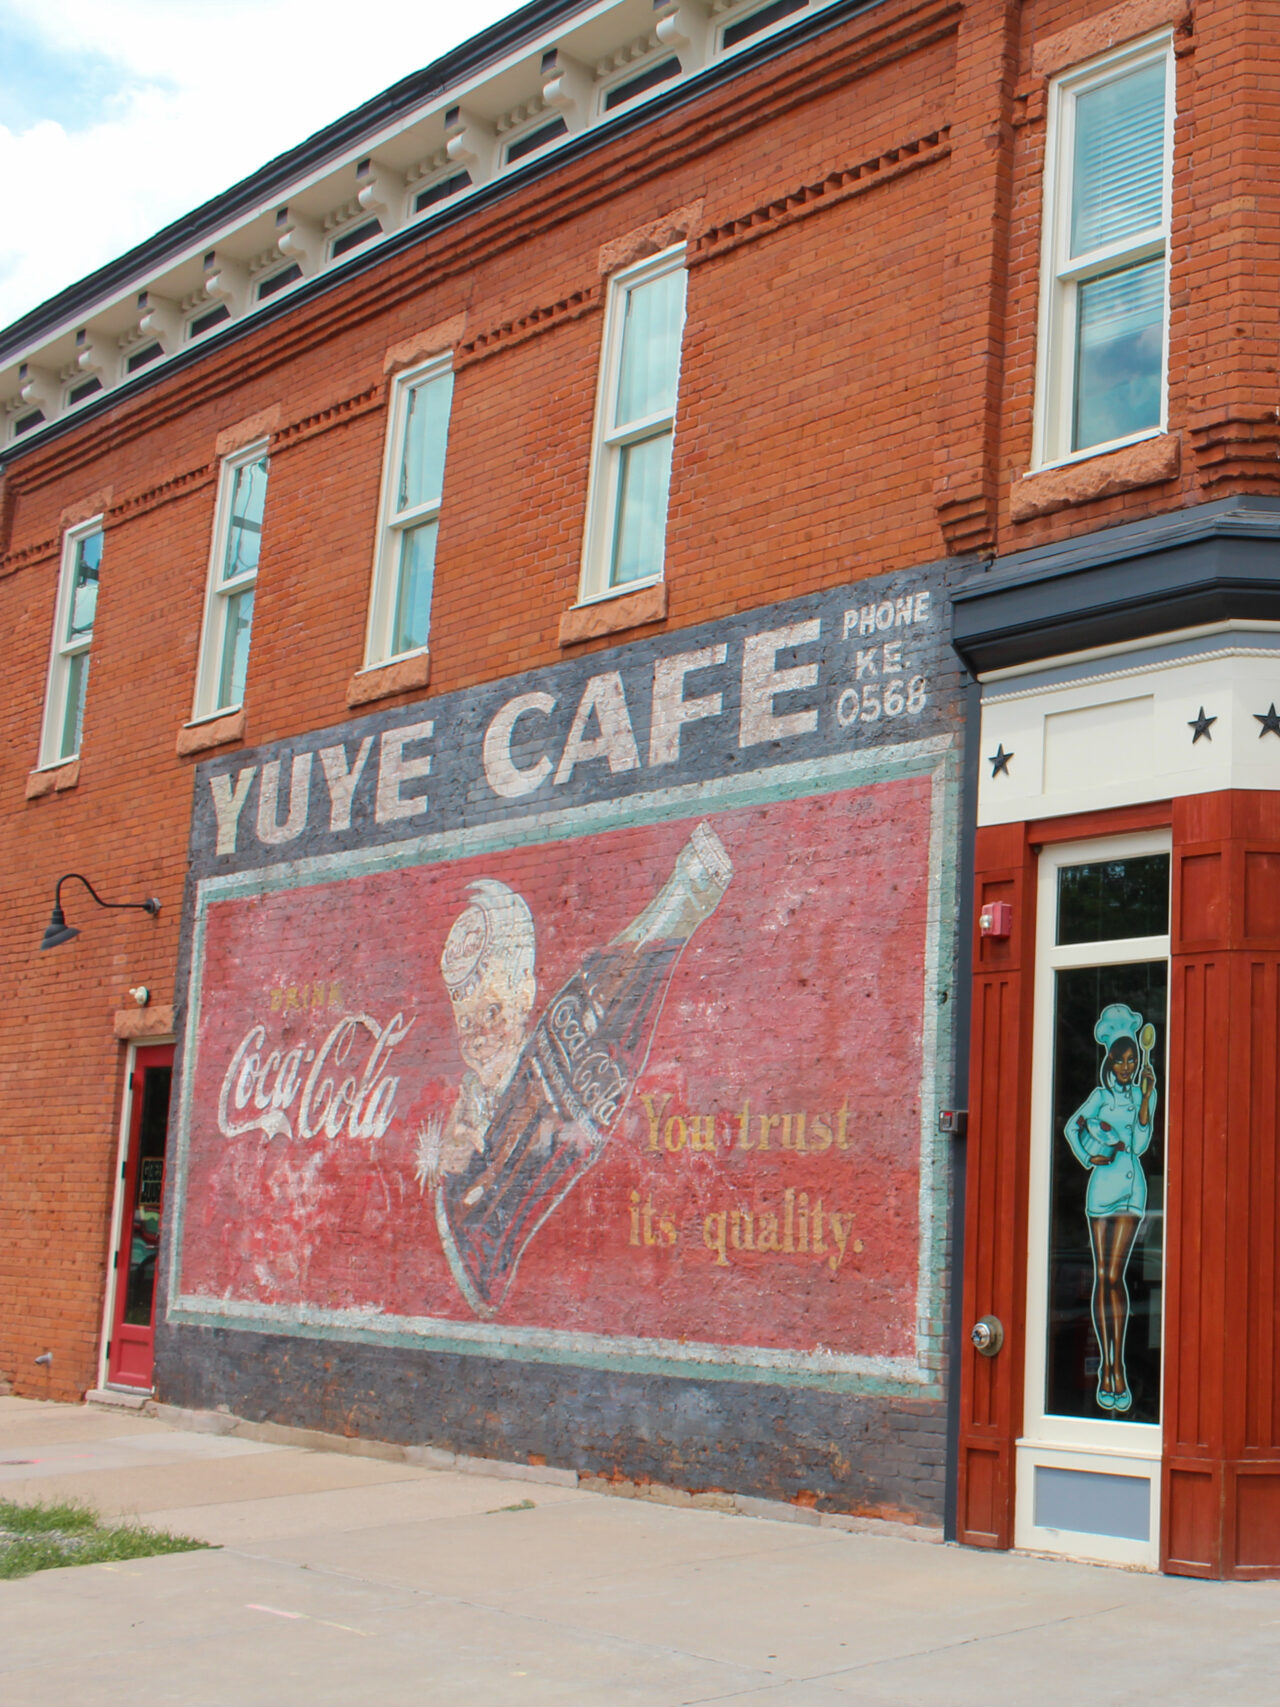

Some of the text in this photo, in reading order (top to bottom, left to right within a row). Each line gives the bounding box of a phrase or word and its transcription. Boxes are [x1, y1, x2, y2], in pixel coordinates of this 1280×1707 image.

[842, 591, 930, 640] PHONE
[856, 641, 911, 680] KE.
[837, 674, 927, 726] 0568
[209, 618, 823, 856] YUYE CAFE
[269, 982, 344, 1012] DRINK
[639, 1093, 852, 1155] You trust
[628, 1188, 865, 1271] its quality.
